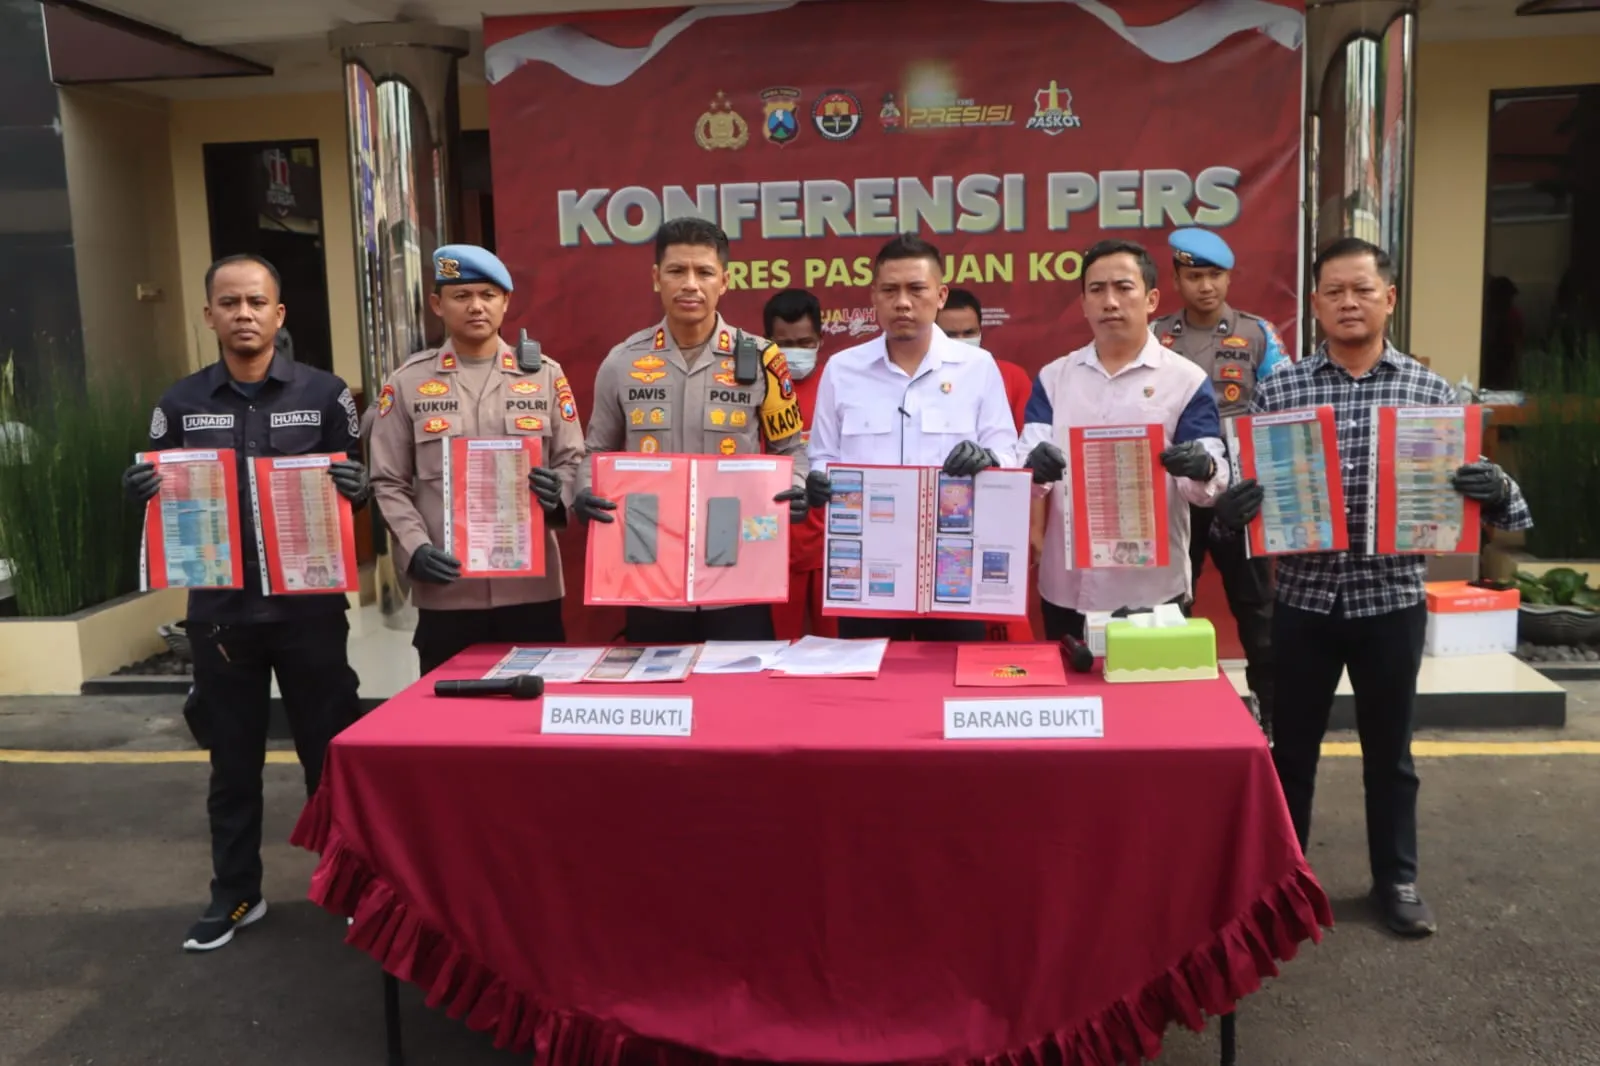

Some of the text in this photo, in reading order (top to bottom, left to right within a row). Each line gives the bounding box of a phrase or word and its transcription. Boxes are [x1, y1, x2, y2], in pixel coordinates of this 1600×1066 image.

[908, 105, 1014, 125] PRESISI
[1026, 115, 1081, 129] PASKOT
[557, 166, 1241, 247] KONFERENSI PERS
[1028, 250, 1085, 282] KO
[1215, 350, 1250, 361] POLRI
[628, 388, 667, 400] DAVIS
[709, 390, 751, 404] POLRI
[413, 400, 459, 413] KUKUH
[506, 400, 548, 411] POLRI
[187, 417, 231, 427] JUNAIDI
[274, 413, 318, 425] HUMAS
[550, 707, 684, 726] BARANG BUKTI
[953, 708, 1095, 728] BARANG BUKTI
